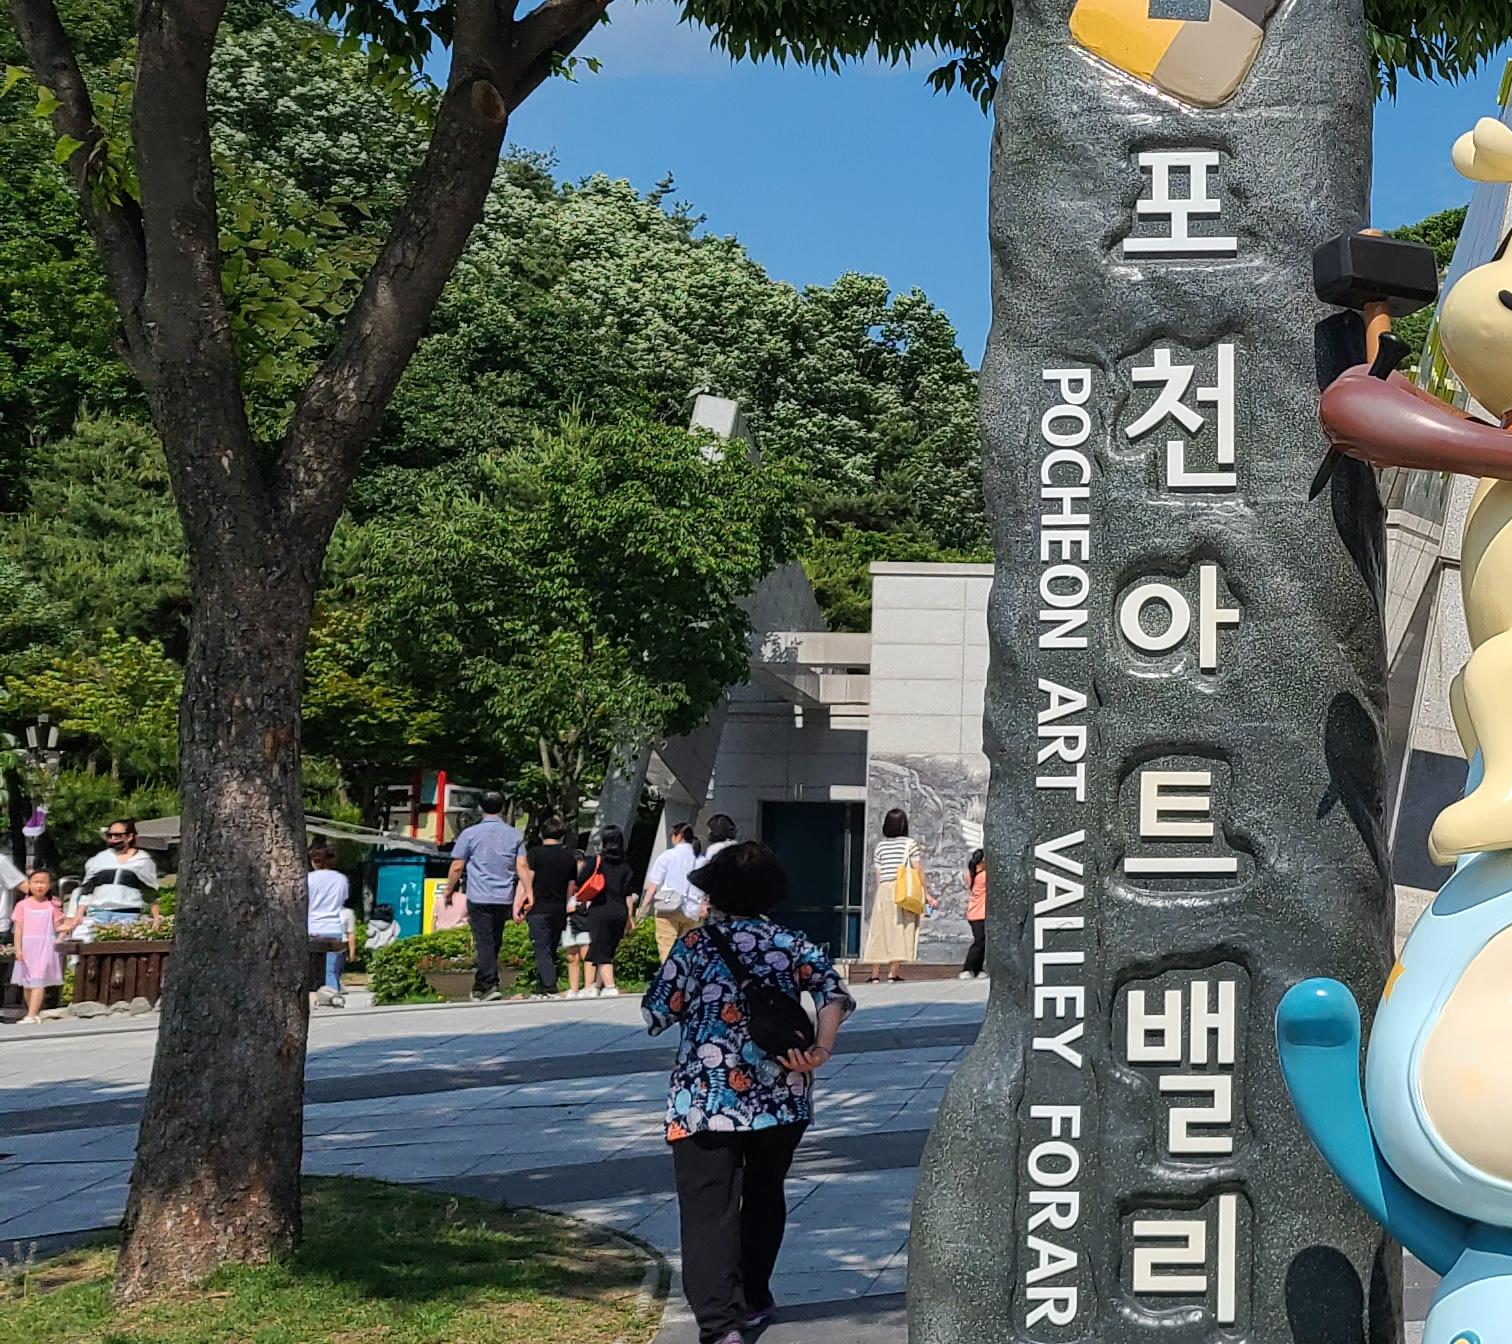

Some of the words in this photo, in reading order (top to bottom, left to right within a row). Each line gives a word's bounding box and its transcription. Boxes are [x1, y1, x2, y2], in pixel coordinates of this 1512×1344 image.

[1038, 368, 1092, 650] POCHEON
[1035, 679, 1088, 803] ART
[1119, 151, 1240, 1323] 포천아트밸리
[1031, 829, 1086, 1069] VALLEY
[1024, 1105, 1082, 1330] FORAR
